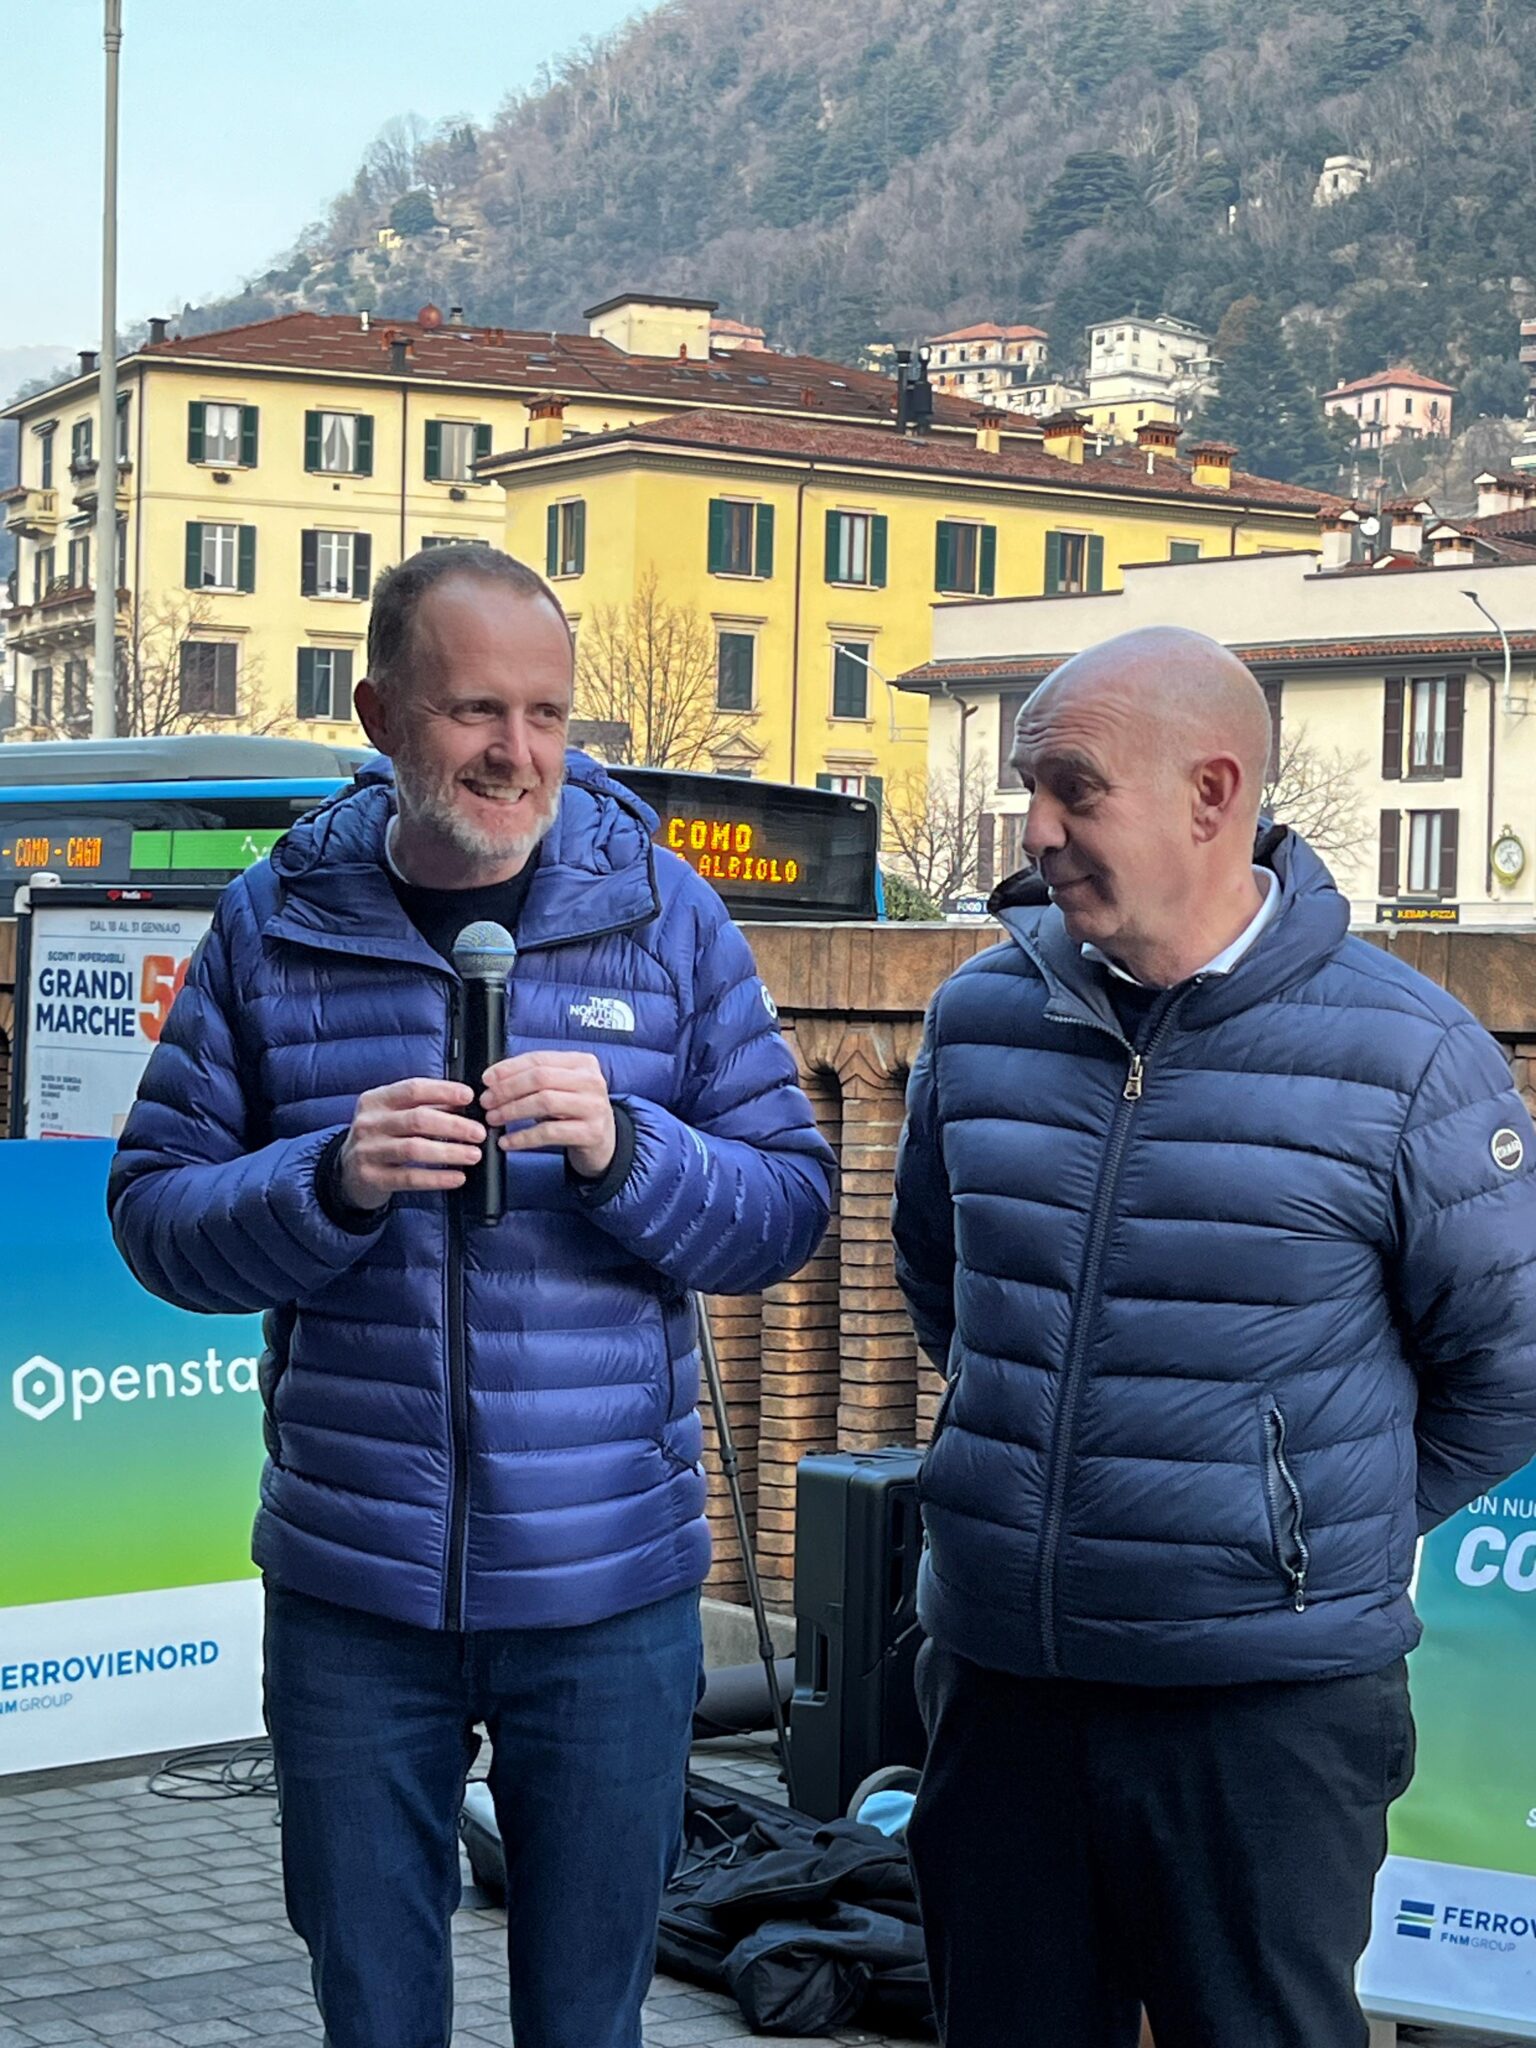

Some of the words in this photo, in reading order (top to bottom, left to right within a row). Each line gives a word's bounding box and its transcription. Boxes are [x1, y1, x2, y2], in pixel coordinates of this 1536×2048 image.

[668, 817, 753, 852] COMO
[698, 853, 798, 883] ALBIOLO
[90, 920, 106, 932] DAL
[141, 922, 181, 934] GENNAIO
[48, 951, 76, 963] SCONTI
[39, 967, 134, 1001] GRANDI
[569, 1004, 613, 1018] NORTH
[589, 996, 614, 1008] THE
[35, 1002, 136, 1037] MARCHE
[580, 1015, 613, 1029] FACE
[1503, 1497, 1536, 1519] NU
